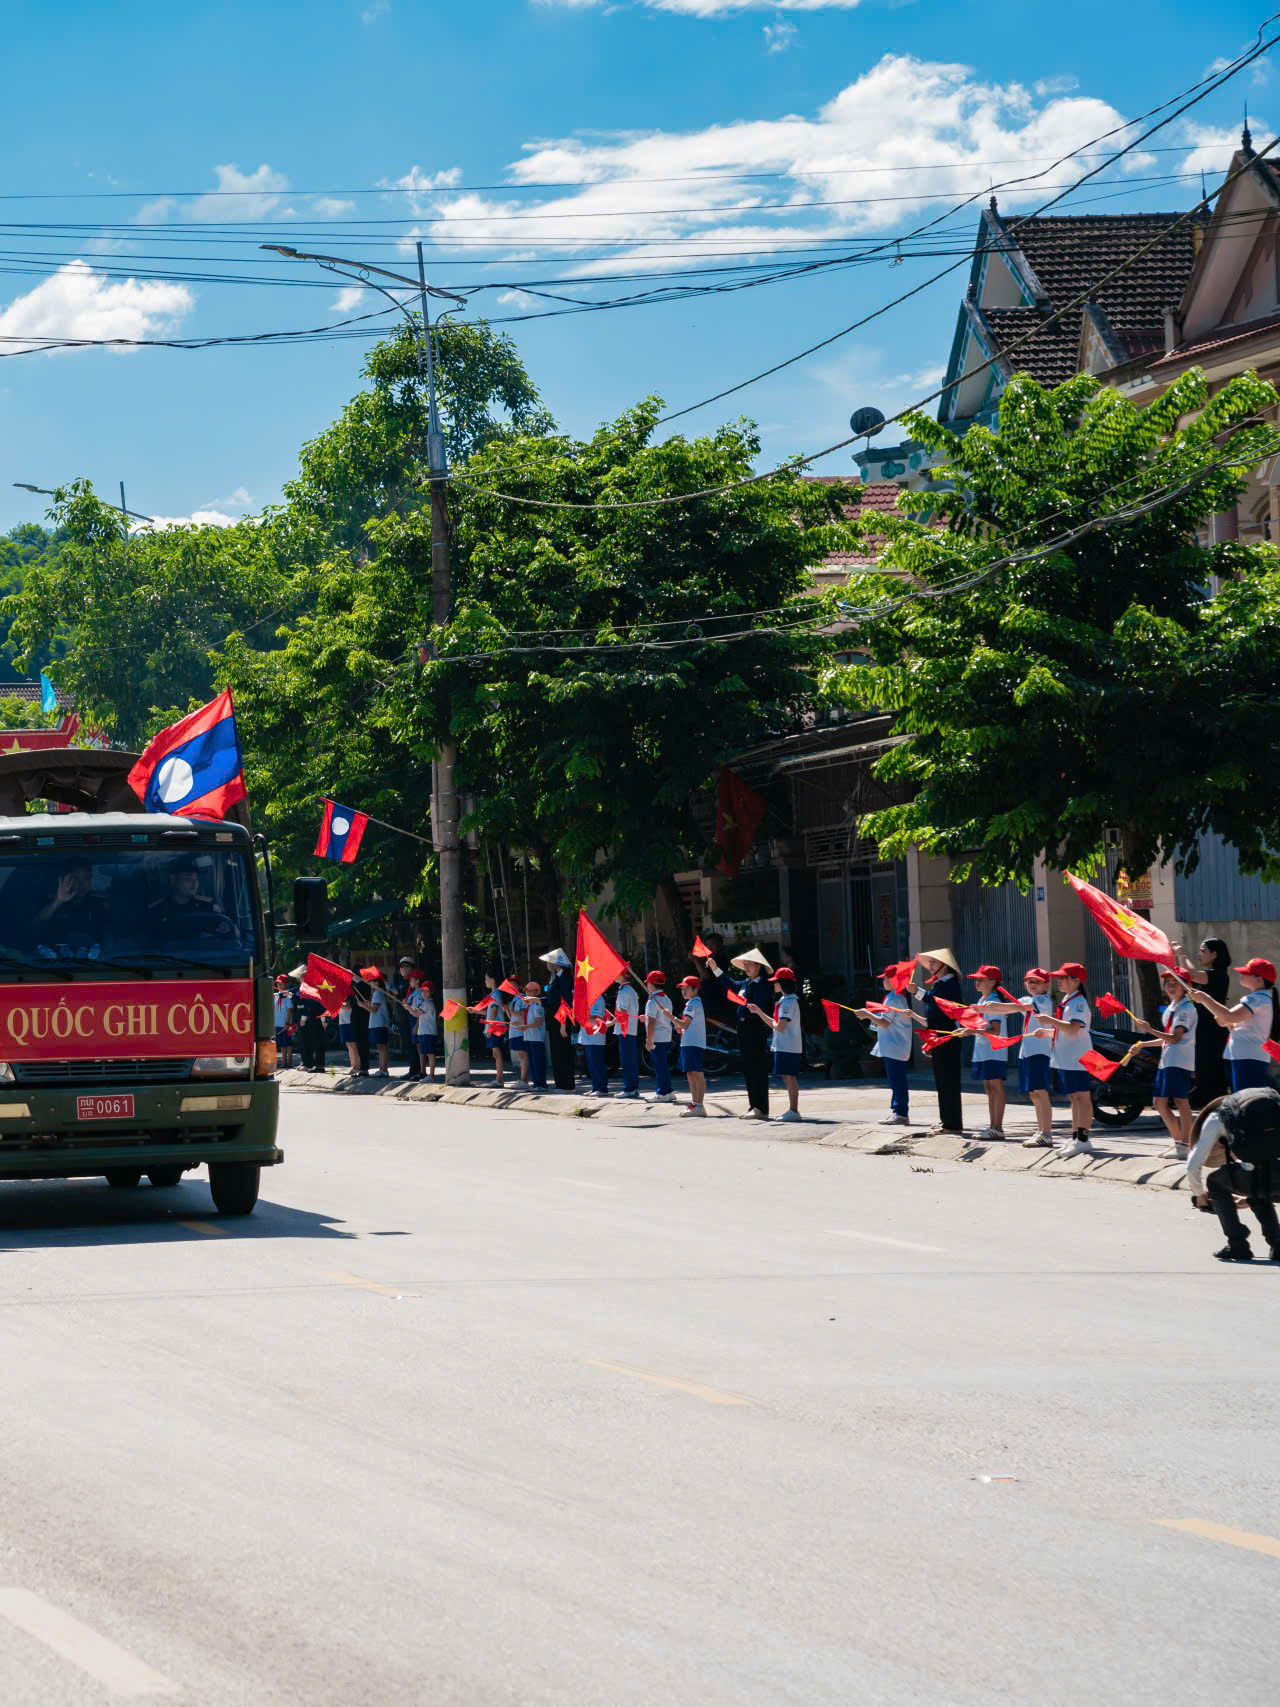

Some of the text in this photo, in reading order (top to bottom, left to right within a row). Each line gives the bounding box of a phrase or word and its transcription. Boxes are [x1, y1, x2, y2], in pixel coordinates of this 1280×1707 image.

[7, 996, 95, 1046] QUỐC
[103, 1004, 160, 1036] GHI
[167, 993, 253, 1035] CÔNG
[96, 1099, 128, 1114] 0061
